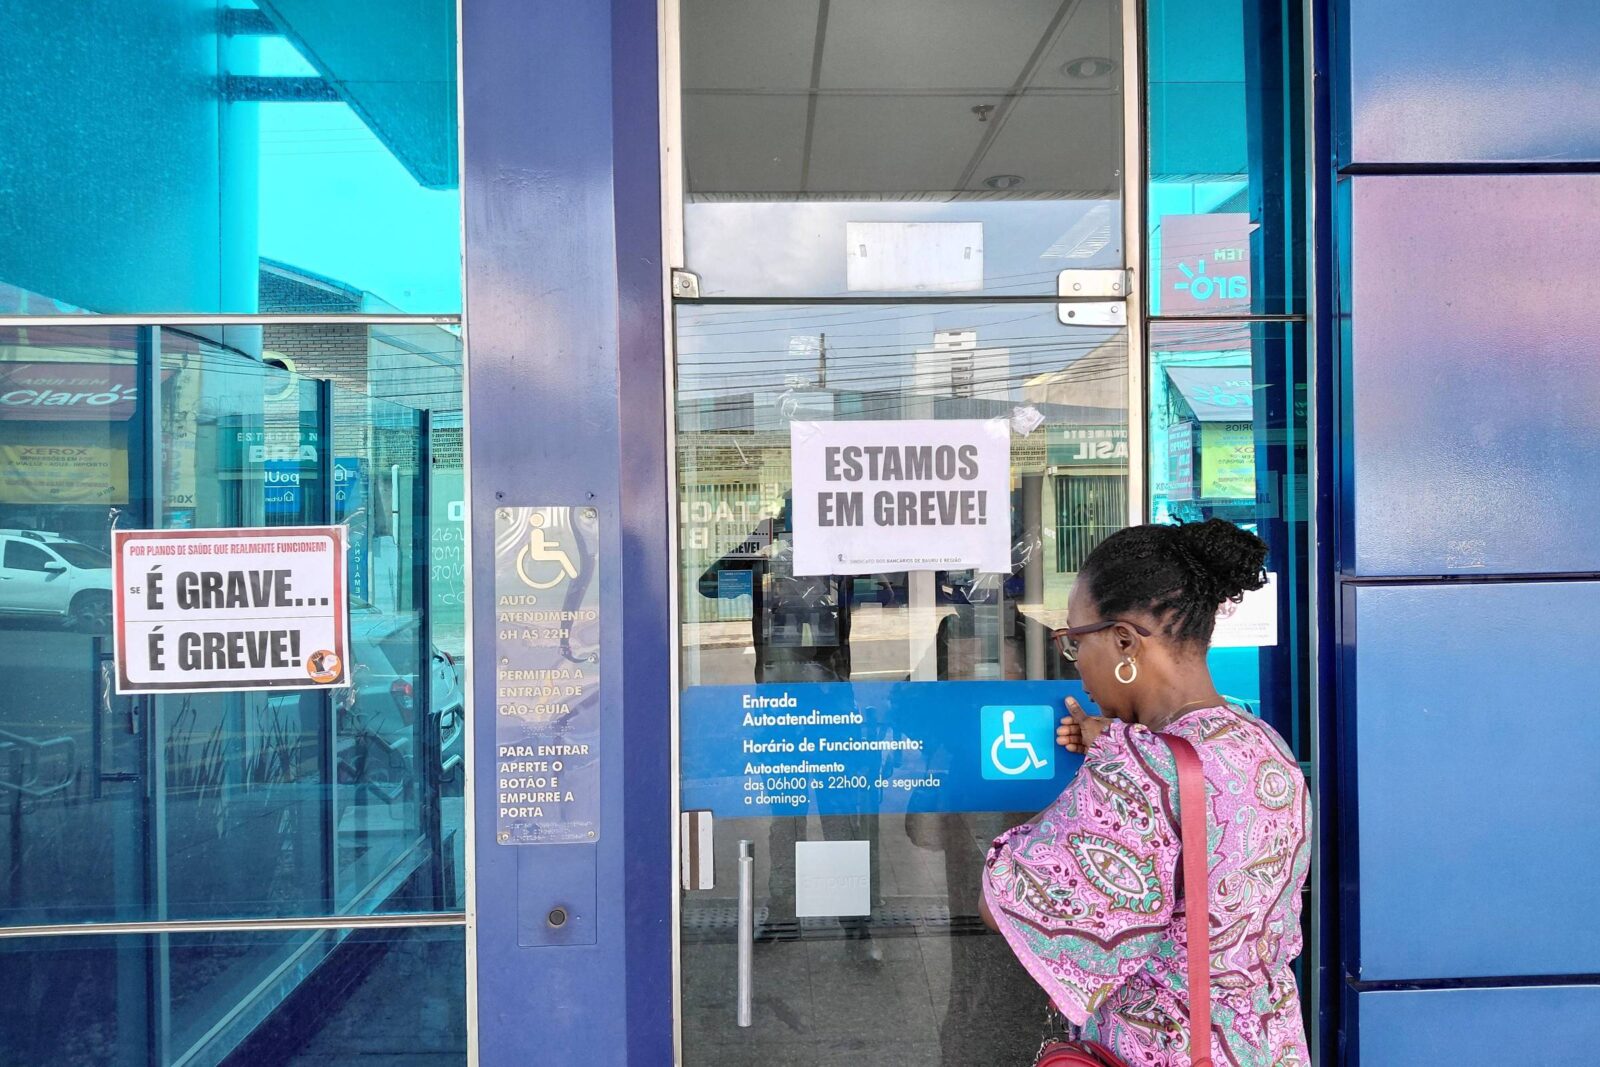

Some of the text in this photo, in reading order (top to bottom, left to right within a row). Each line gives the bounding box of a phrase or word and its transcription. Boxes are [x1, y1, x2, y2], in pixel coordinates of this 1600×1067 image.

[825, 444, 979, 482] ESTAMOS
[818, 490, 987, 527] EM GREVE!
[130, 541, 327, 556] POR PLANOS DE SAÚDE QUE REALMENTE FUNCIONEM!
[130, 564, 329, 611] SE É GRAVE...
[499, 595, 537, 606] AUTO
[499, 610, 597, 622] ATENDIMENTO
[500, 629, 518, 640] 6H
[543, 628, 570, 640] 22H
[148, 625, 302, 671] É GREVE!
[500, 669, 584, 681] PERMITIDA A
[500, 686, 582, 698] ENTRADA DE
[742, 692, 797, 709] Entrada
[500, 702, 571, 716] CÃO-GUIA
[742, 710, 864, 727] Autoatendimento
[500, 744, 589, 757] PARA ENTRAR
[743, 737, 924, 754] Horário de Funcionamento:
[500, 761, 563, 773] APERTE O
[744, 761, 845, 775] Autoatendimento
[500, 775, 558, 789] BOTÃO E
[744, 774, 940, 791] das 06h00 às 22h00, de segunda
[500, 791, 575, 804] EMPURRE A
[744, 790, 811, 807] a domingo.
[500, 807, 544, 819] PORTA
